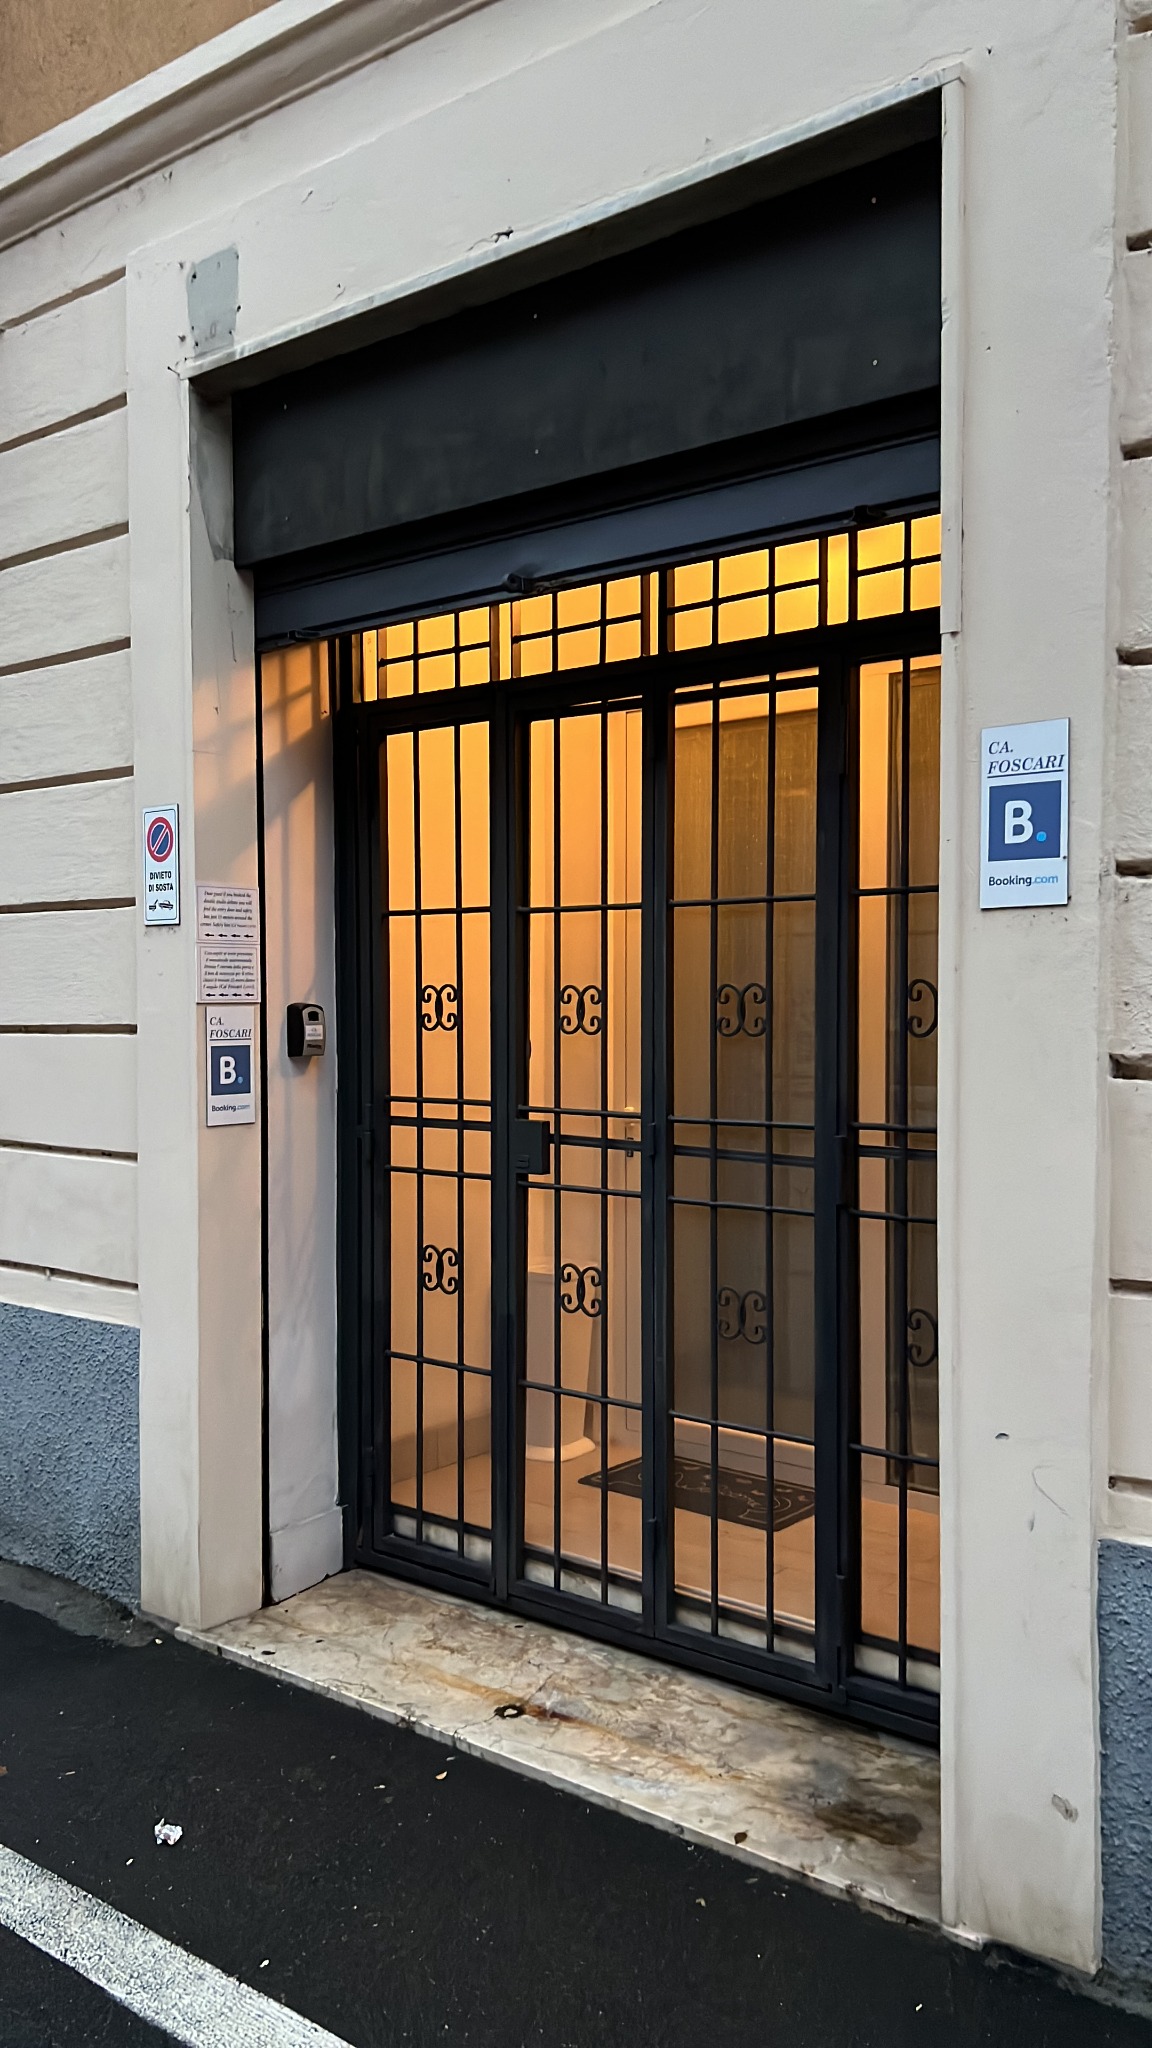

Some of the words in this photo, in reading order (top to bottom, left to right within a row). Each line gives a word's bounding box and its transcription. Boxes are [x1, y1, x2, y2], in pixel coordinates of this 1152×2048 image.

[988, 741, 1014, 755] CA.
[987, 754, 1065, 774] FOSCARI
[149, 871, 172, 880] DIVIETO
[988, 874, 1059, 887] Booking.com
[148, 884, 154, 892] DI
[155, 883, 174, 892] SOSTA
[209, 1017, 225, 1026] CA.
[209, 1028, 252, 1039] FOSCARI
